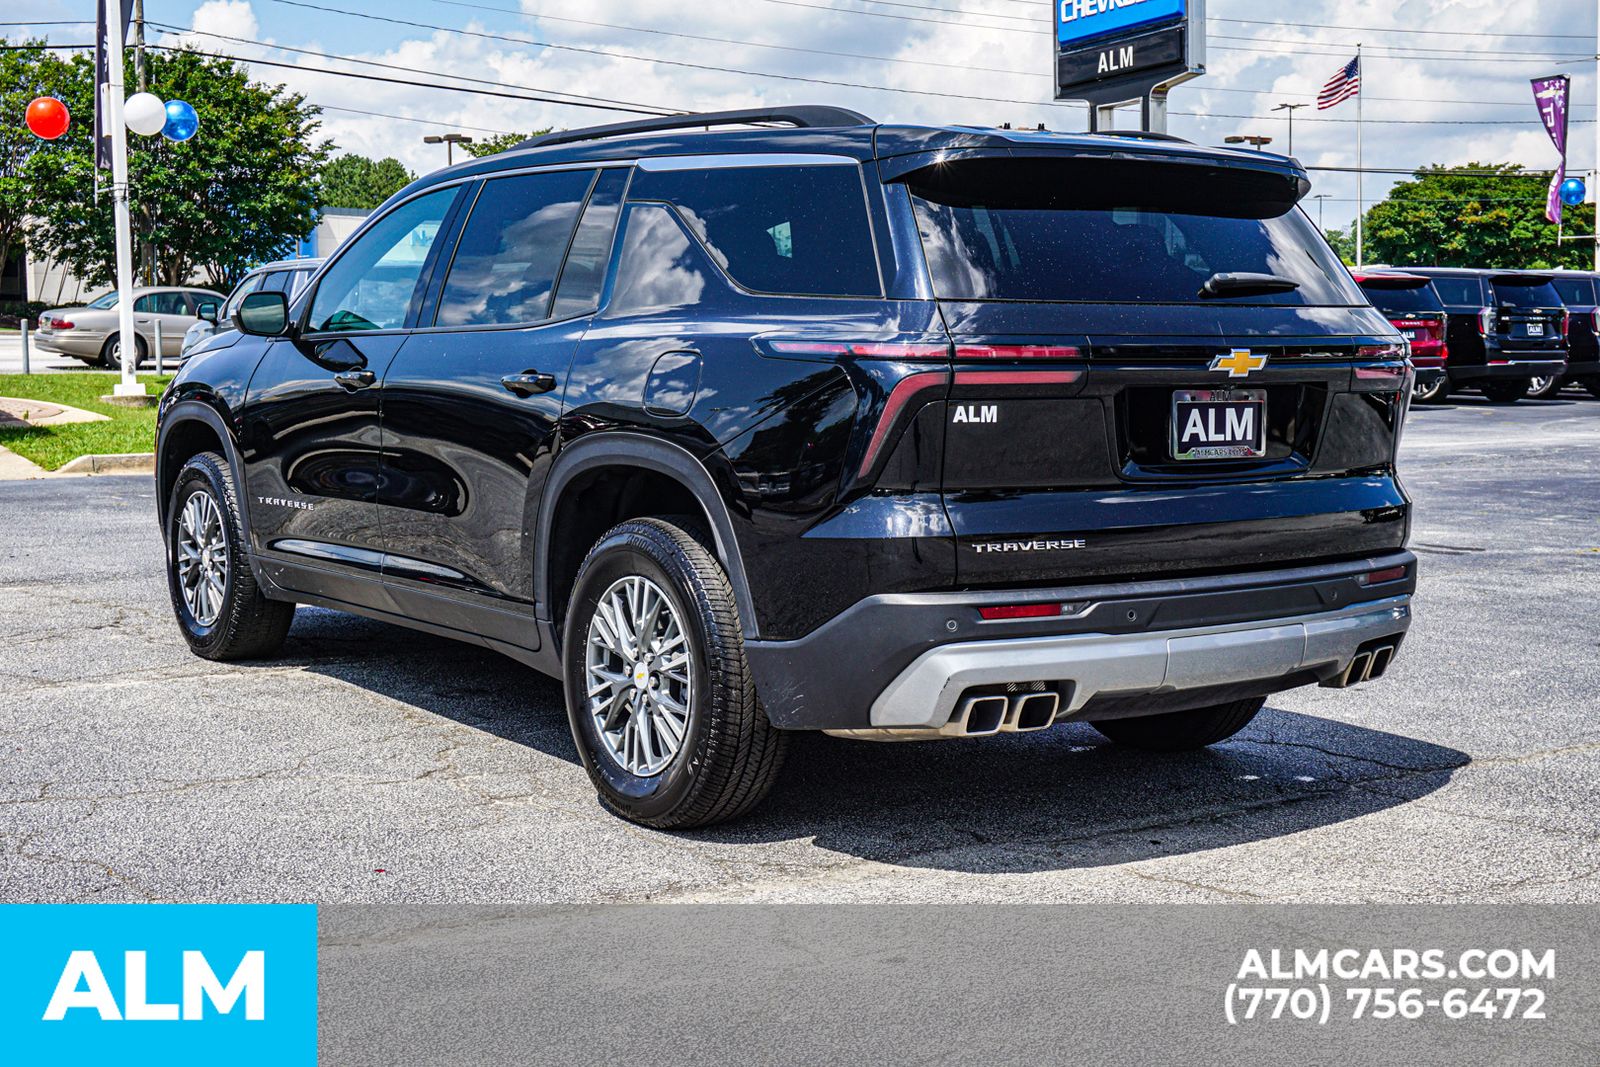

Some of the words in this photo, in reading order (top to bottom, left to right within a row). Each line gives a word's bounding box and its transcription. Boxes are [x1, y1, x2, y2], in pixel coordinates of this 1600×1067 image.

[1097, 46, 1134, 73] ALM
[953, 405, 998, 423] ALM
[1181, 407, 1254, 442] ALM
[257, 496, 315, 511] TRAVERSE
[971, 539, 1086, 554] TRAVERSE
